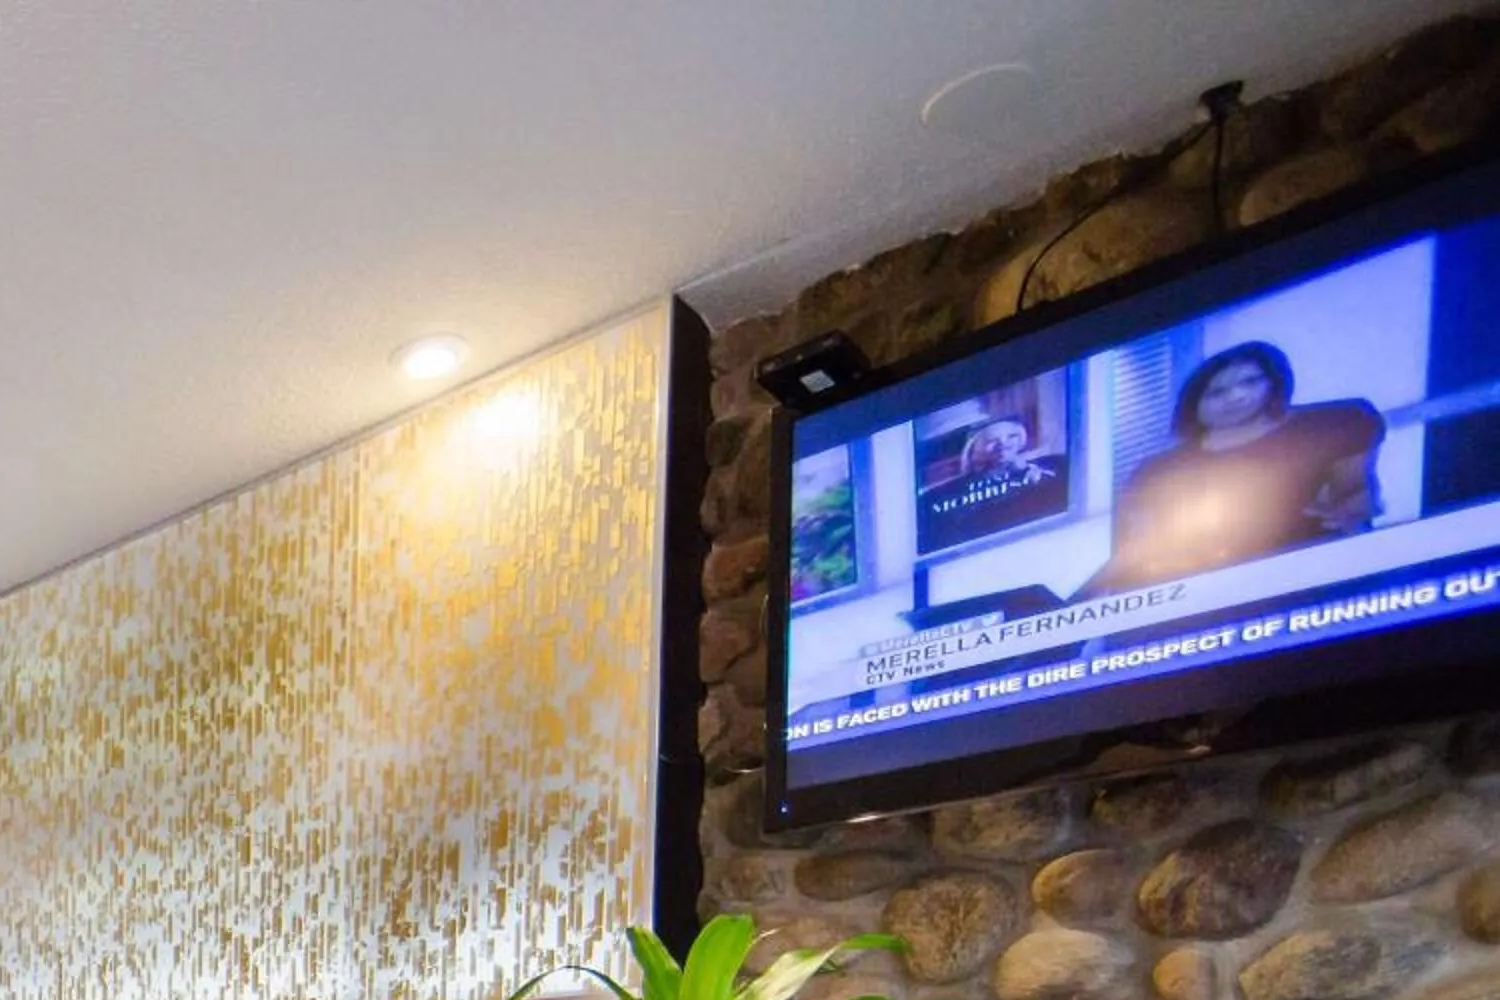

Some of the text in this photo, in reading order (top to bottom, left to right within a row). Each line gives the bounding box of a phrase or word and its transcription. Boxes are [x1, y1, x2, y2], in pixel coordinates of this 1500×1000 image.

[813, 717, 833, 735] IS
[837, 702, 909, 730] FACED
[911, 687, 971, 713] WITH
[973, 676, 1022, 699] THE
[1027, 663, 1086, 688] DIRE
[1091, 627, 1237, 676] PROSPECT
[1242, 616, 1285, 641] OF
[1289, 585, 1438, 633] RUNNING
[866, 631, 992, 674] MERELLA
[999, 583, 1187, 641] FERNANDEZ
[903, 660, 946, 677] News
